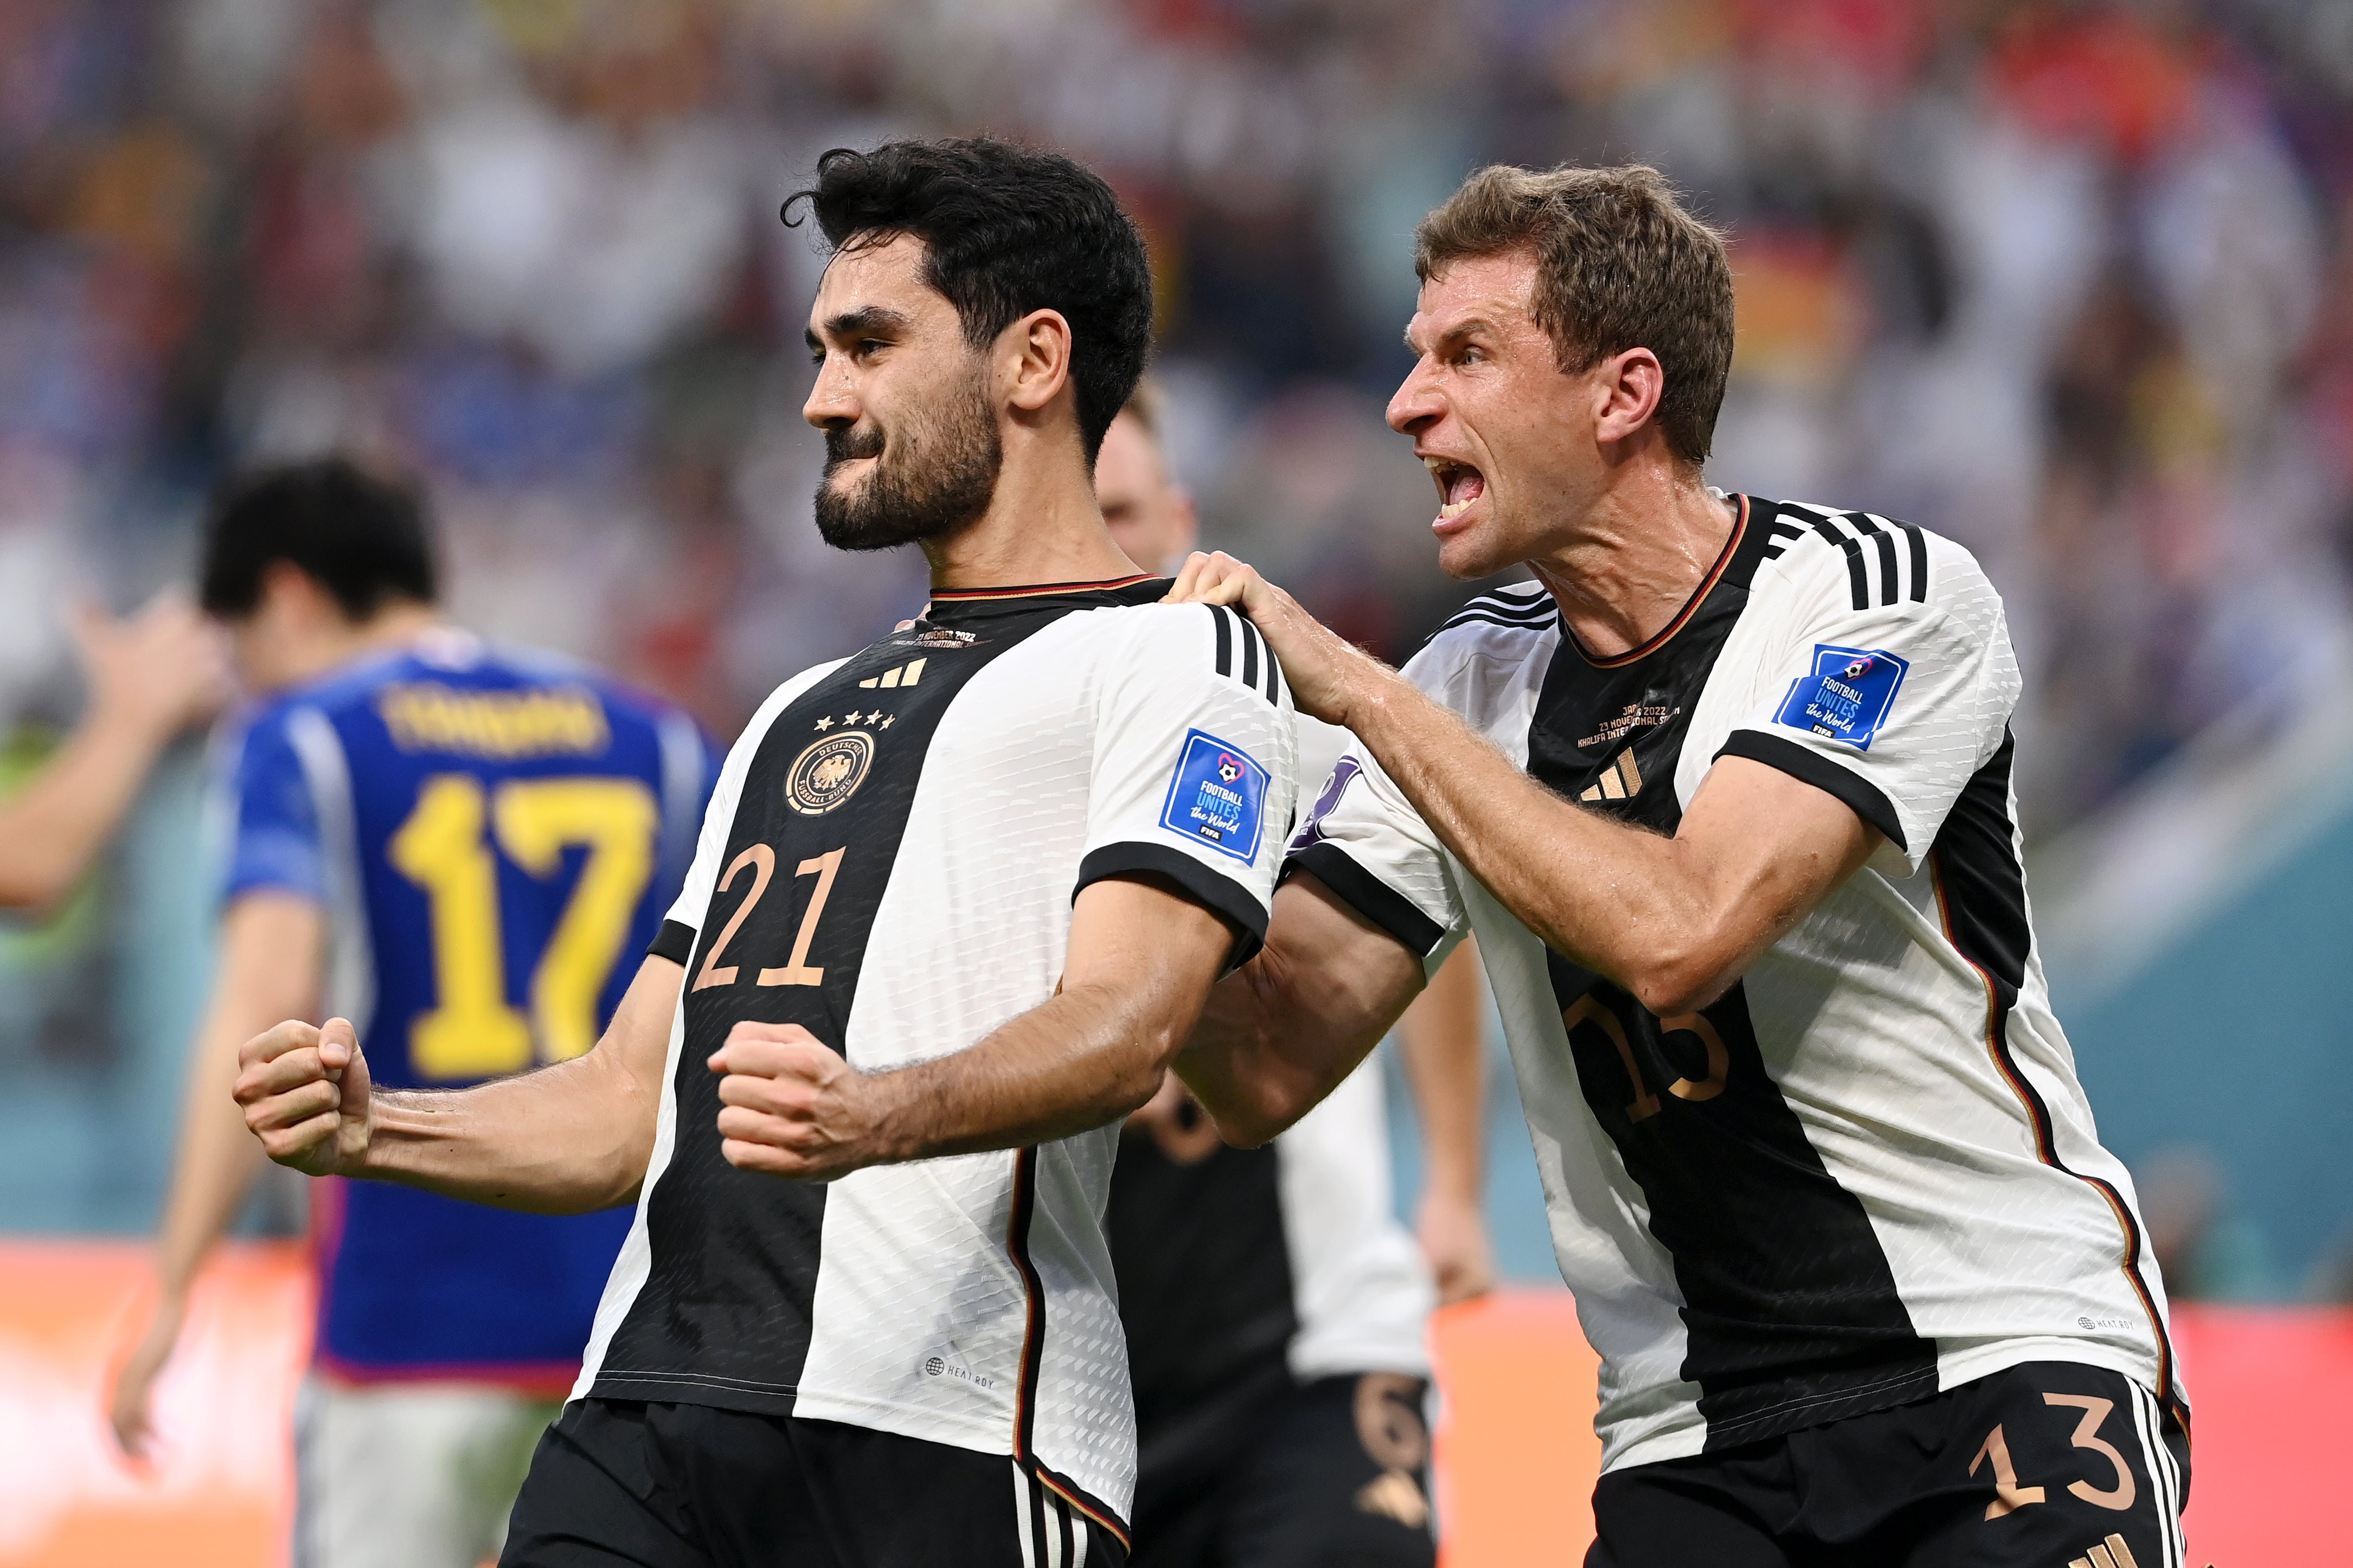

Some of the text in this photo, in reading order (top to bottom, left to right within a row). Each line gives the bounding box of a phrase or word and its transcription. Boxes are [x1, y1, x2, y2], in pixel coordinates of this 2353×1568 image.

[914, 640, 964, 648] INTERNATIONAL
[924, 631, 954, 640] NOVEMBER
[955, 631, 976, 642] 2022
[1815, 687, 1859, 718] UNITES
[1821, 676, 1863, 704] FOOTBALL
[1599, 722, 1609, 732] 23
[1643, 706, 1666, 716] 2022
[1806, 703, 1855, 734] the World
[1813, 725, 1833, 738] FIFA
[818, 742, 863, 756] DEUTSCHER
[1578, 733, 1606, 748] KHALIFA
[798, 779, 852, 803] FUSSBALL-BUND
[1200, 780, 1243, 807] FOOTBALL
[1196, 792, 1241, 820] UNITES
[1189, 806, 1240, 835] the World
[1200, 826, 1221, 840] FIFA
[389, 774, 661, 1080] 17
[690, 843, 847, 994] 21
[1354, 1371, 1429, 1473] 6
[1968, 1392, 2136, 1522] 13
